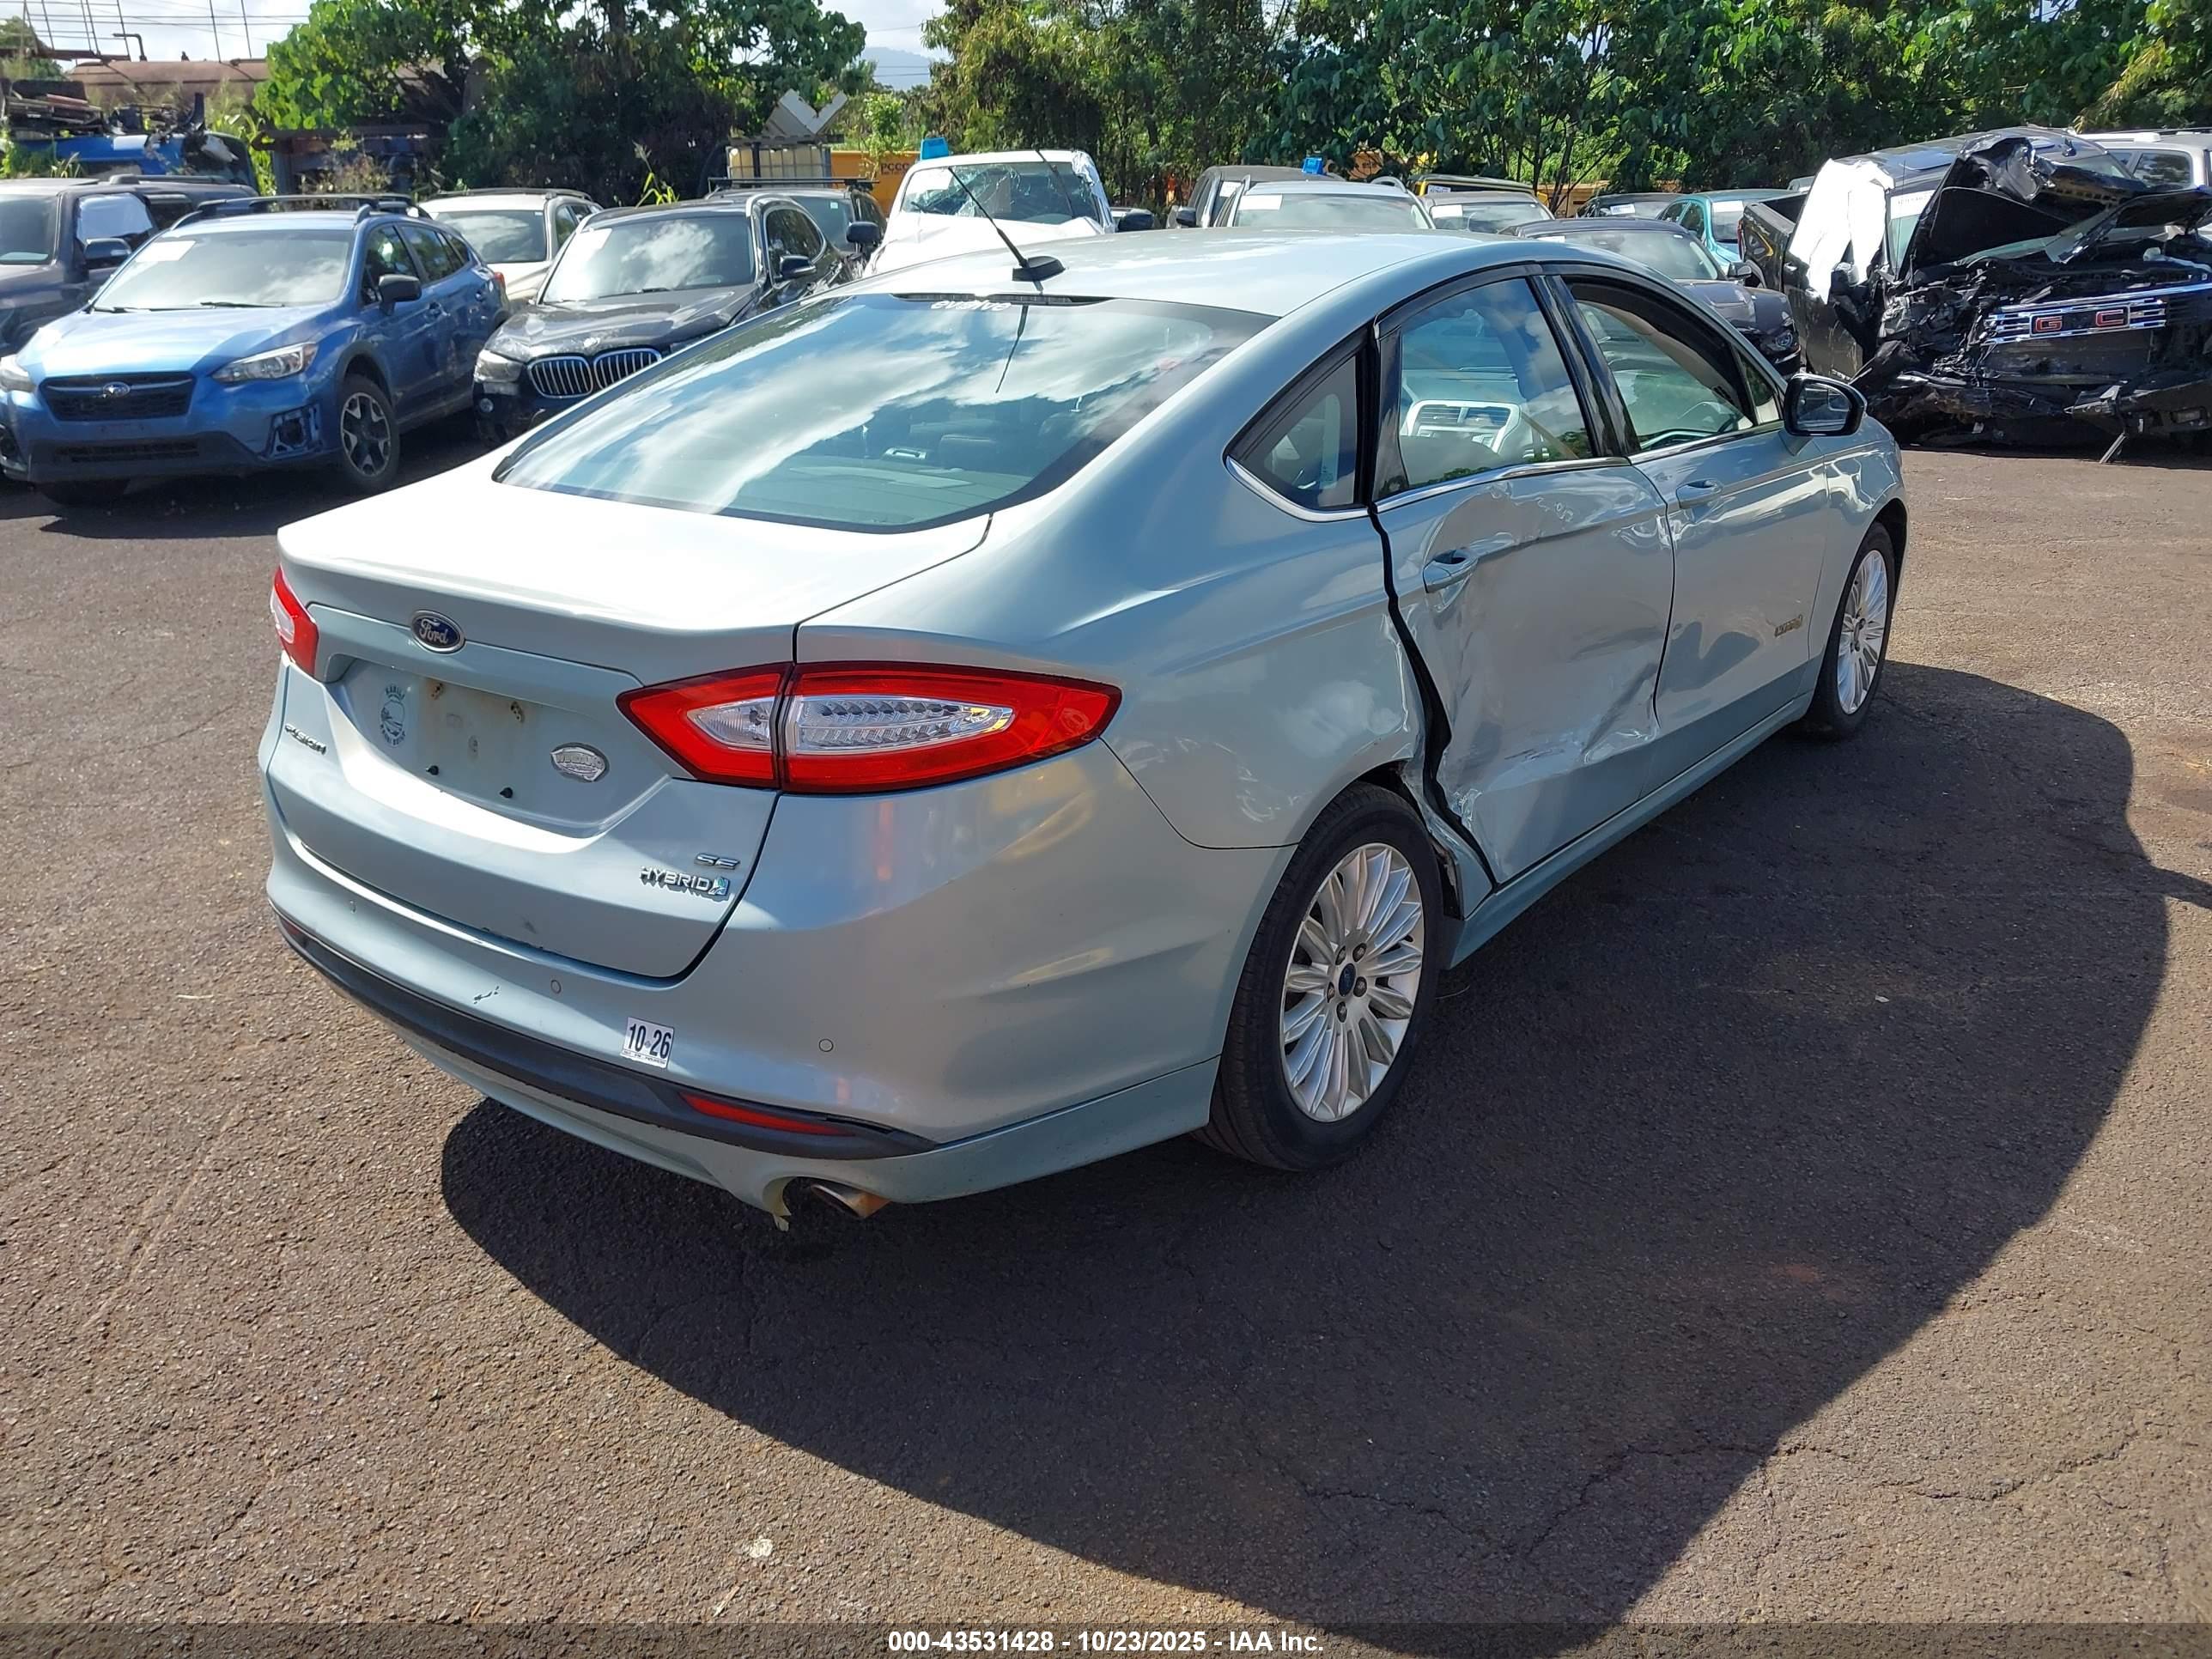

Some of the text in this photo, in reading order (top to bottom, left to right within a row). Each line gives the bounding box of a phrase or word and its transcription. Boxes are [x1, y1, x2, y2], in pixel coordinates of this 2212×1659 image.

[419, 618, 449, 644] Ford
[696, 853, 740, 869] SE
[639, 866, 712, 891] HYBRID
[629, 1023, 647, 1053] 10
[649, 1029, 672, 1059] 26
